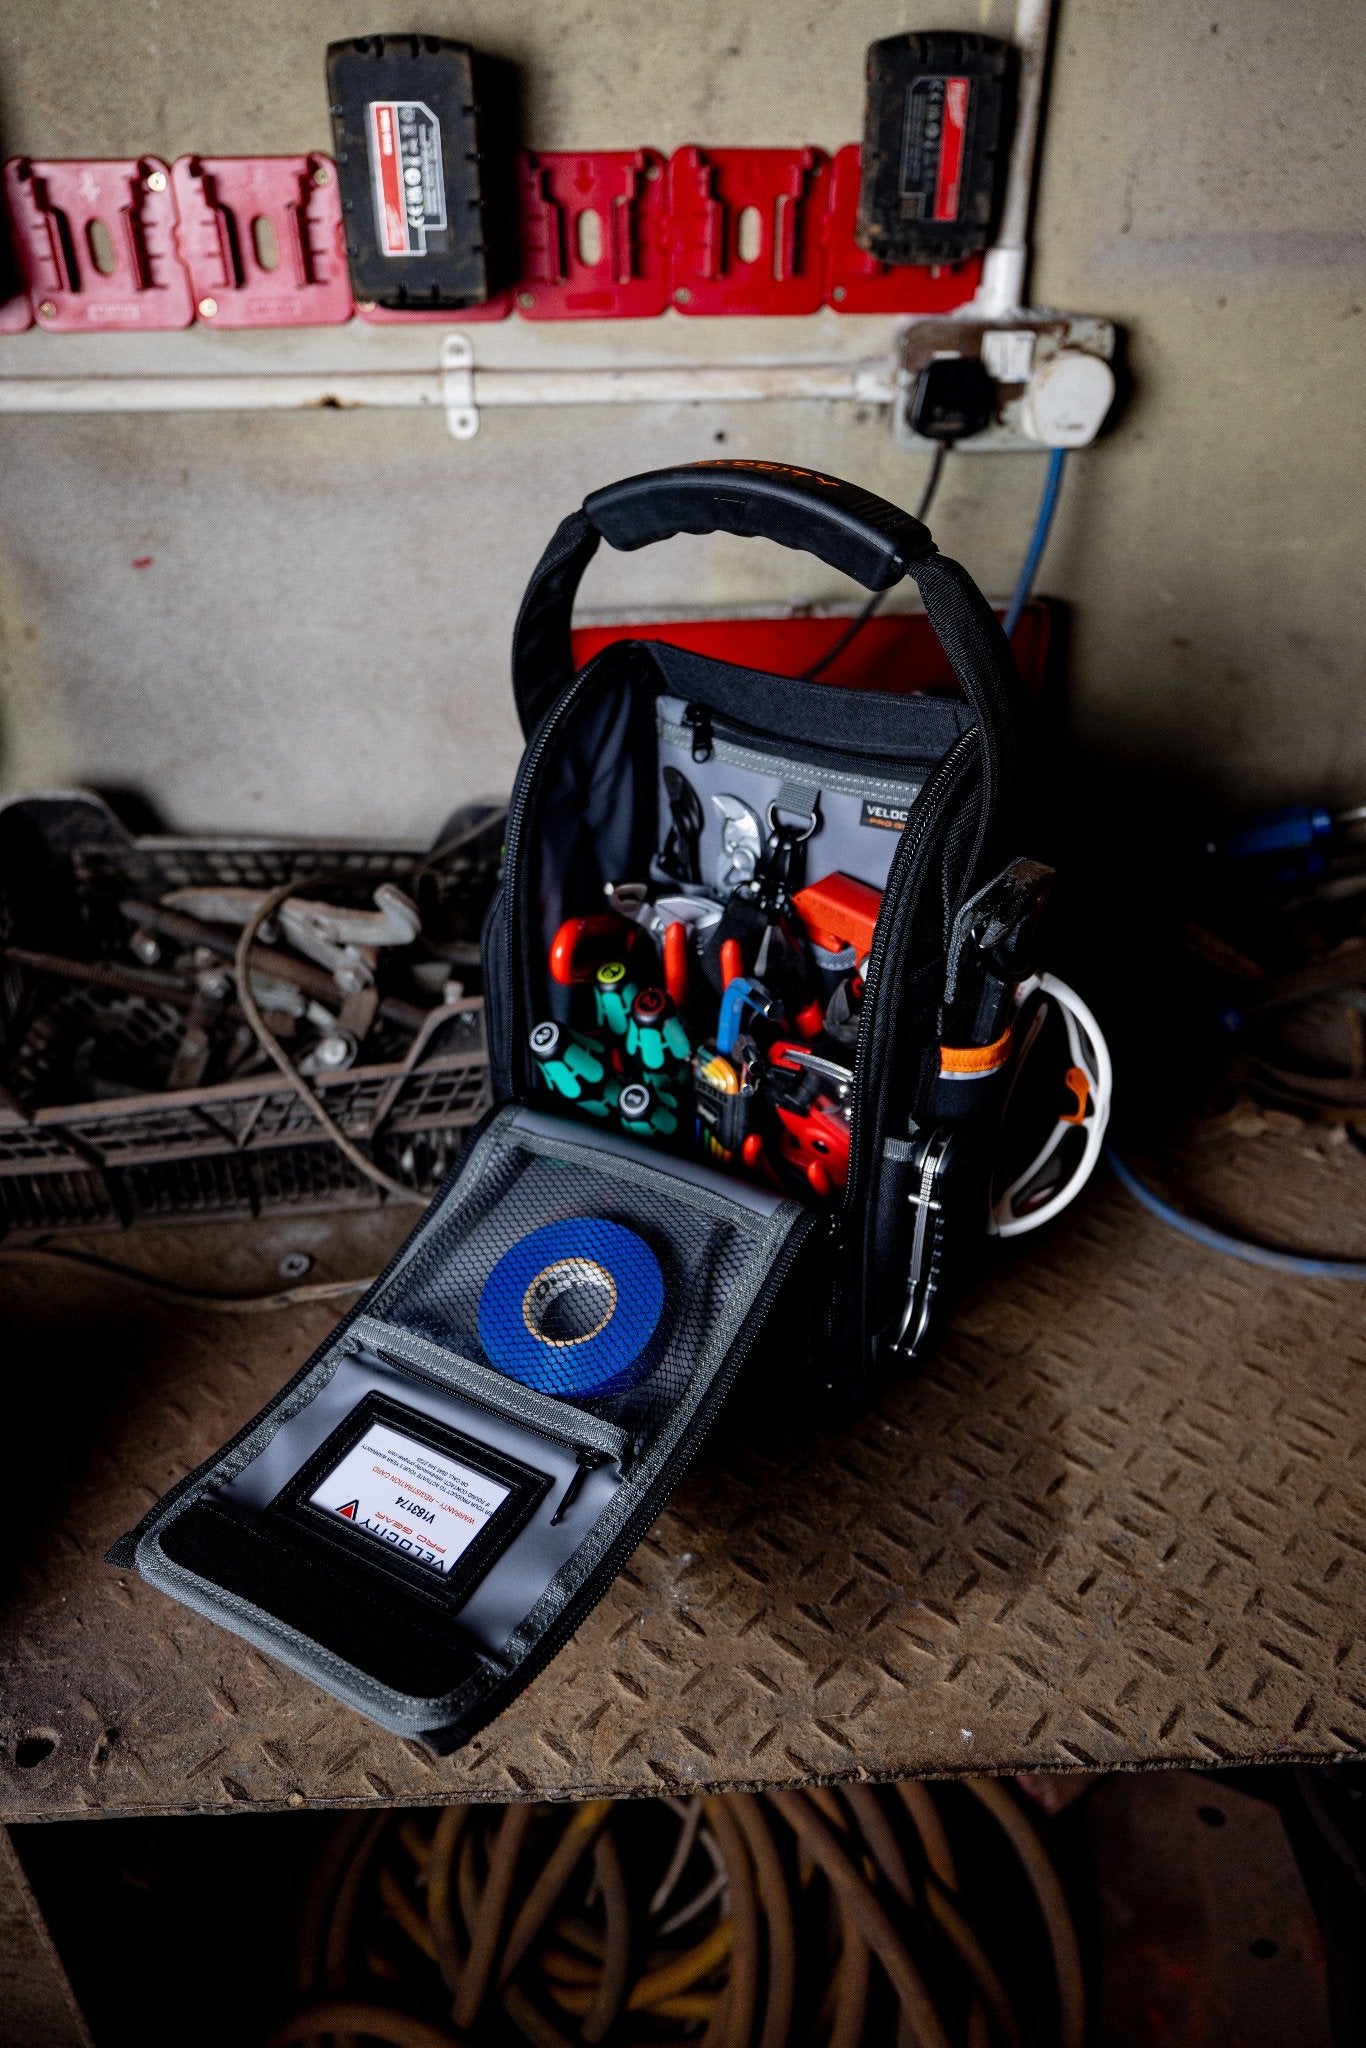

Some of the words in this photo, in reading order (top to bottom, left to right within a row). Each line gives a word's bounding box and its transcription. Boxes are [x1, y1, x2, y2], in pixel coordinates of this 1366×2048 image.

[866, 805, 909, 821] VELOC
[361, 1444, 387, 1459] WARRANTY
[387, 1457, 399, 1466] YEAR
[372, 1467, 390, 1478] CARD
[403, 1466, 416, 1475] YOUR
[416, 1473, 440, 1487] ACTIVATE
[449, 1474, 460, 1483] CALL
[390, 1476, 435, 1502] REGISTRATION
[439, 1485, 447, 1493] TO
[446, 1490, 471, 1504] PRODUCT
[468, 1493, 485, 1504] FOUND
[395, 1496, 435, 1524] V183174
[439, 1503, 475, 1524] WARRANTY
[470, 1502, 484, 1512] YOUR
[375, 1512, 412, 1534] GEAR
[358, 1519, 444, 1570] VELOCITY
[417, 1535, 446, 1553] PRO
